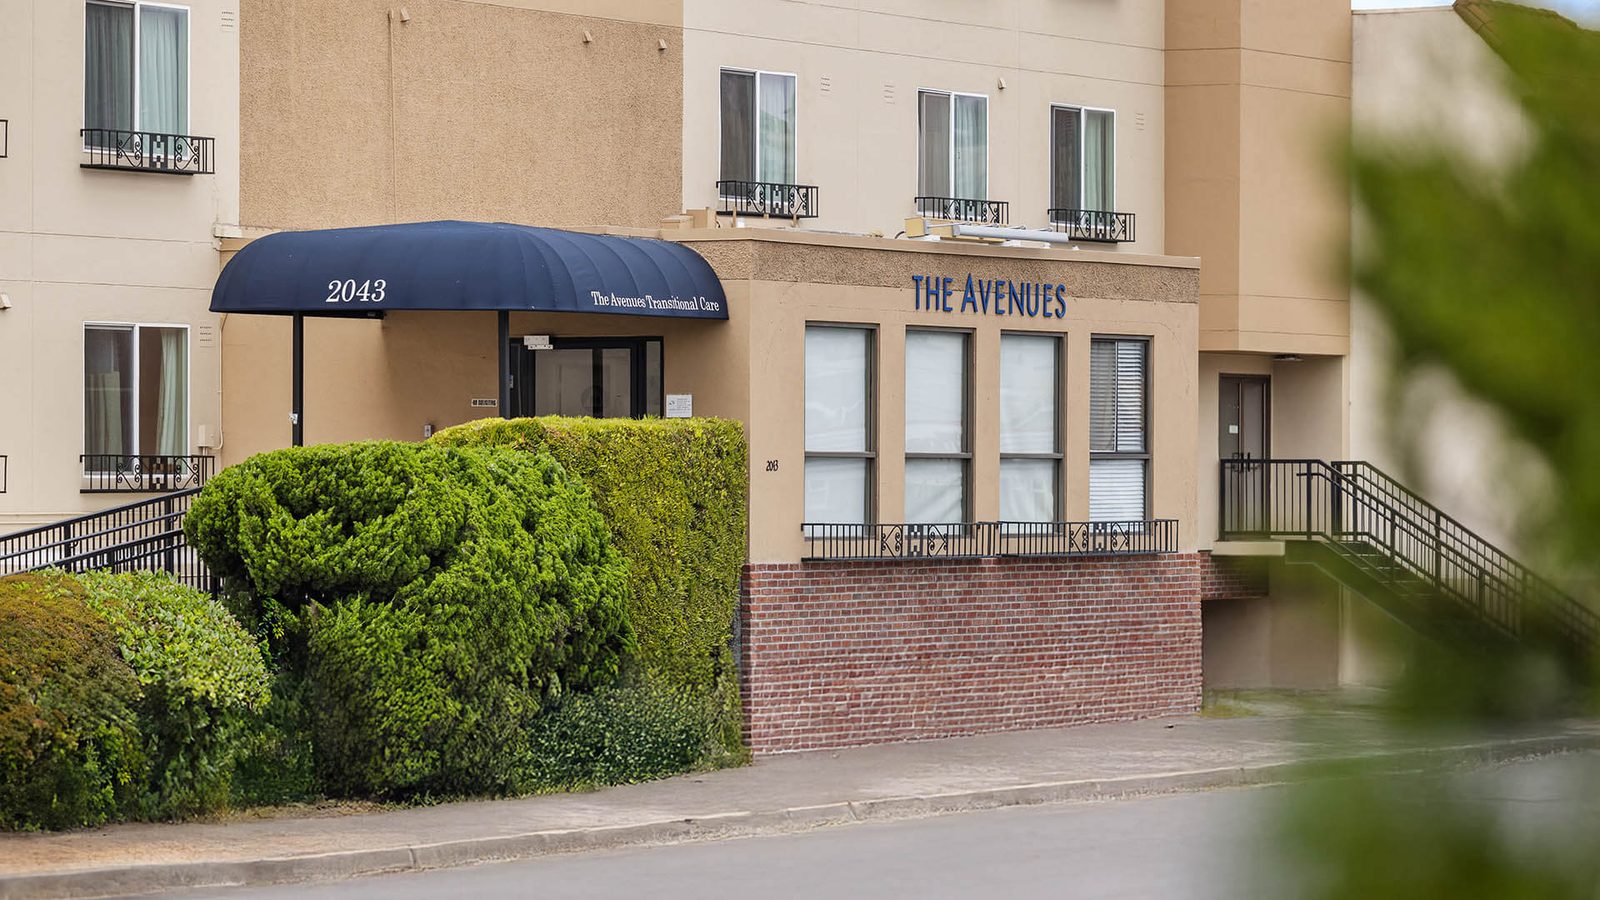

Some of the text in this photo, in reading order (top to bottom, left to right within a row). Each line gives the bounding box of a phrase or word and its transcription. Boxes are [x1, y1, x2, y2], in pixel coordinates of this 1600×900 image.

[325, 279, 387, 303] 2043
[590, 291, 720, 311] The Avenues Transitional Care
[912, 273, 1066, 318] THE AVENUES
